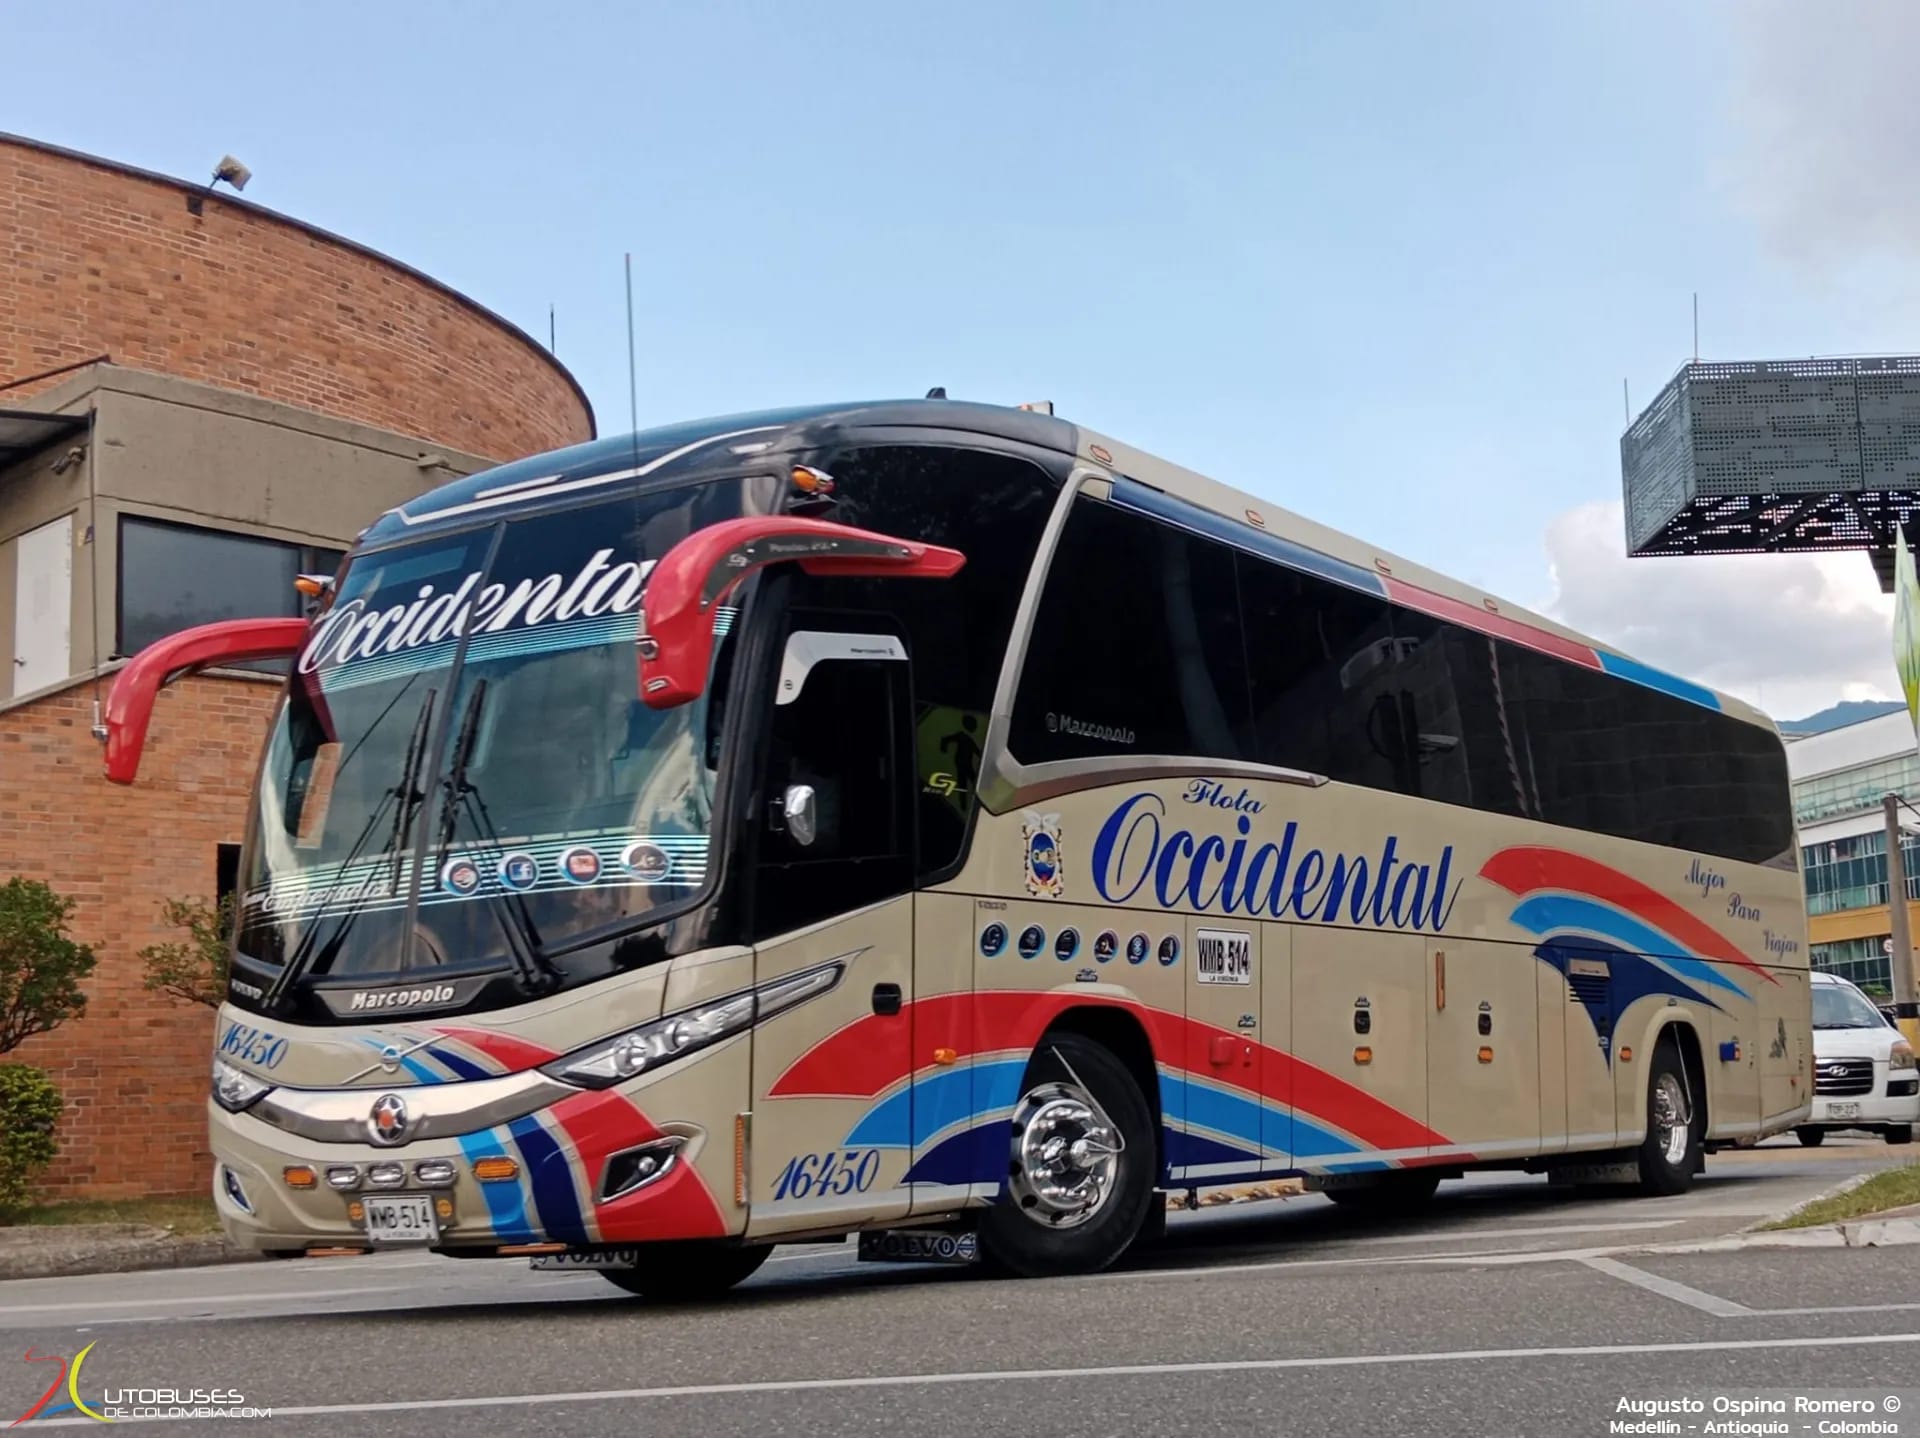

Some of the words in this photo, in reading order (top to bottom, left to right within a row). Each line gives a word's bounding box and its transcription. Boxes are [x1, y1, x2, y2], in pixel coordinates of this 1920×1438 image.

[300, 547, 658, 673] Occidenta
[1060, 714, 1135, 744] Marcopolo
[1182, 778, 1265, 815] Flota
[1092, 792, 1464, 932] Occidental
[1685, 858, 1725, 898] Mejor
[1727, 892, 1760, 921] Para
[1228, 939, 1249, 975] 514
[1763, 928, 1798, 960] Viajar
[351, 985, 455, 1011] Marcopolo
[219, 1022, 290, 1071] 16450
[771, 1147, 880, 1201] 16450
[400, 1205, 431, 1229] 514
